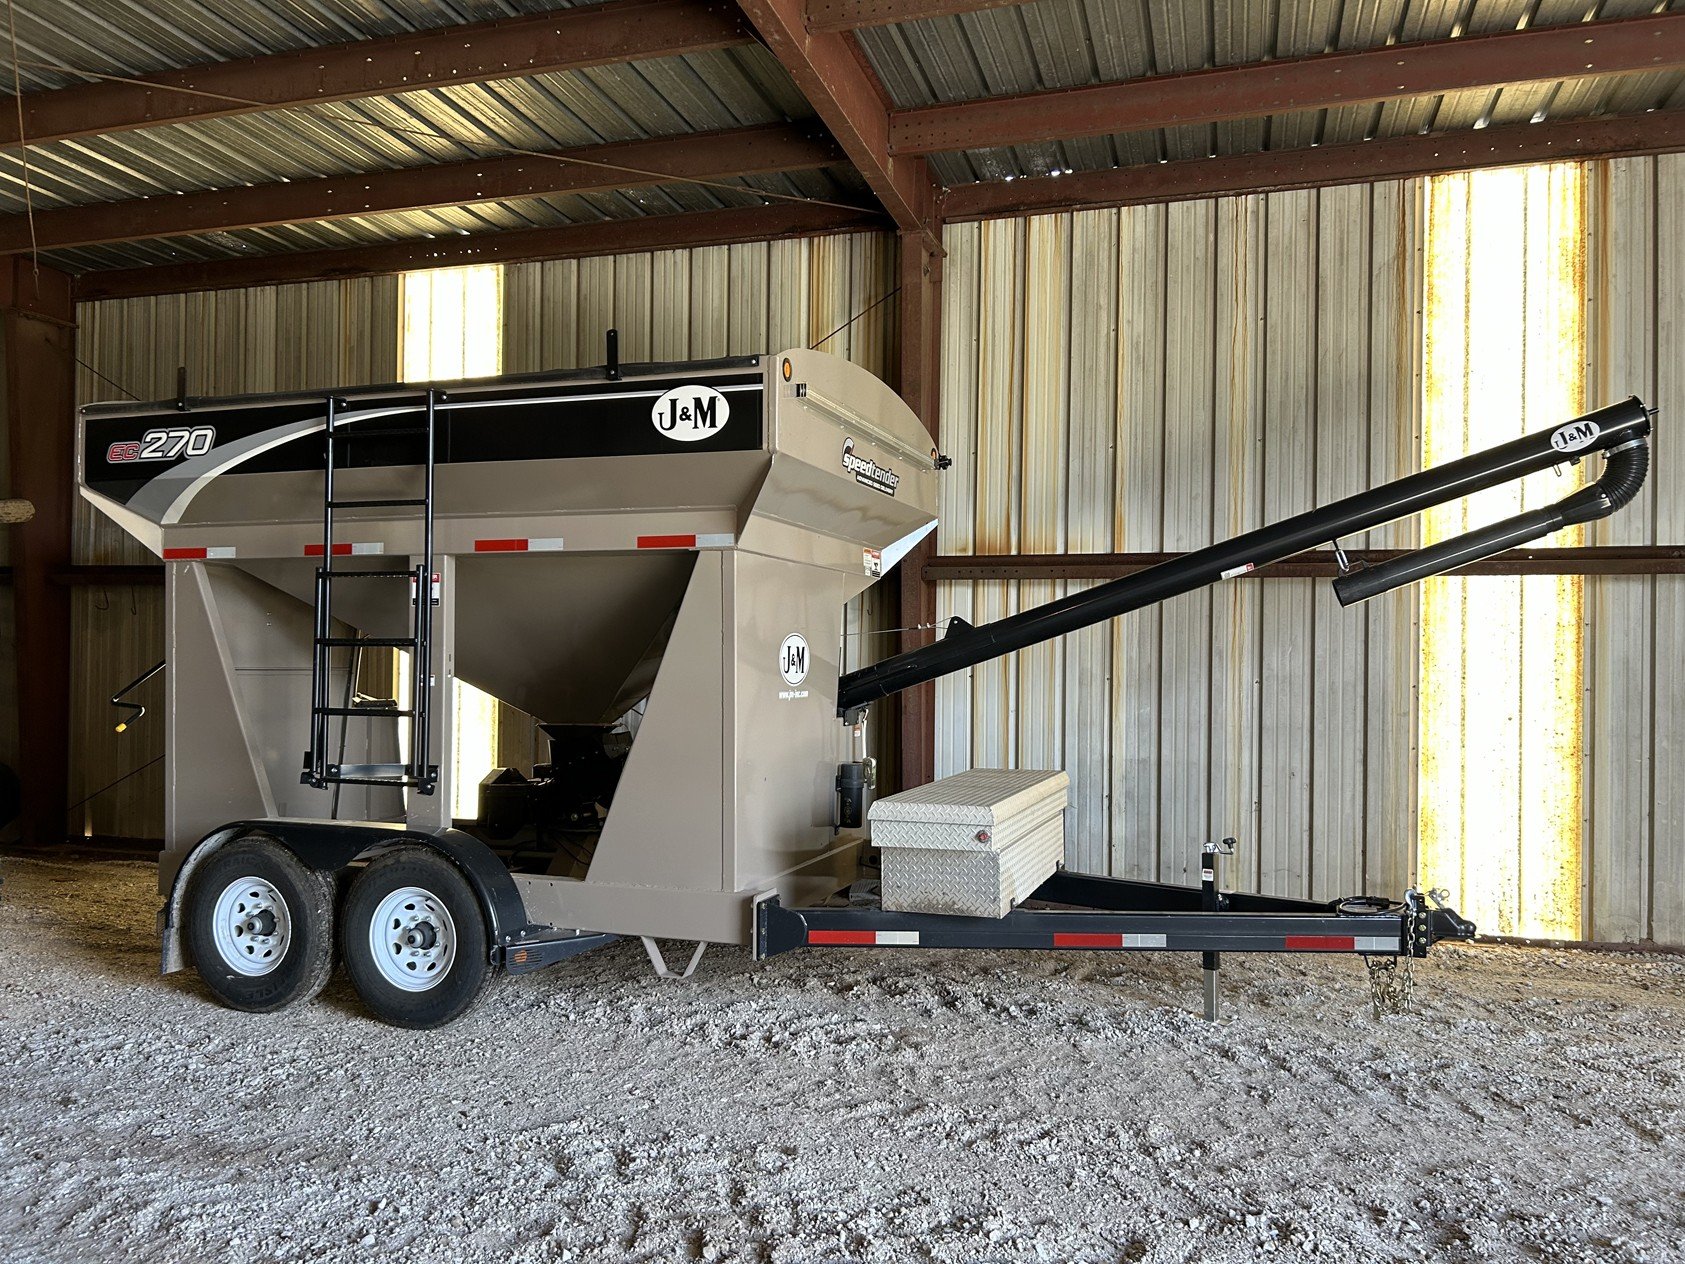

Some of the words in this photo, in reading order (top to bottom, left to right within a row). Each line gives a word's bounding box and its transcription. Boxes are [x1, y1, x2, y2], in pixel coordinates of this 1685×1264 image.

[657, 395, 719, 431] J&M
[108, 443, 141, 461] EC
[140, 428, 214, 458] 270
[1554, 422, 1595, 450] J&M
[783, 645, 805, 674] J&M
